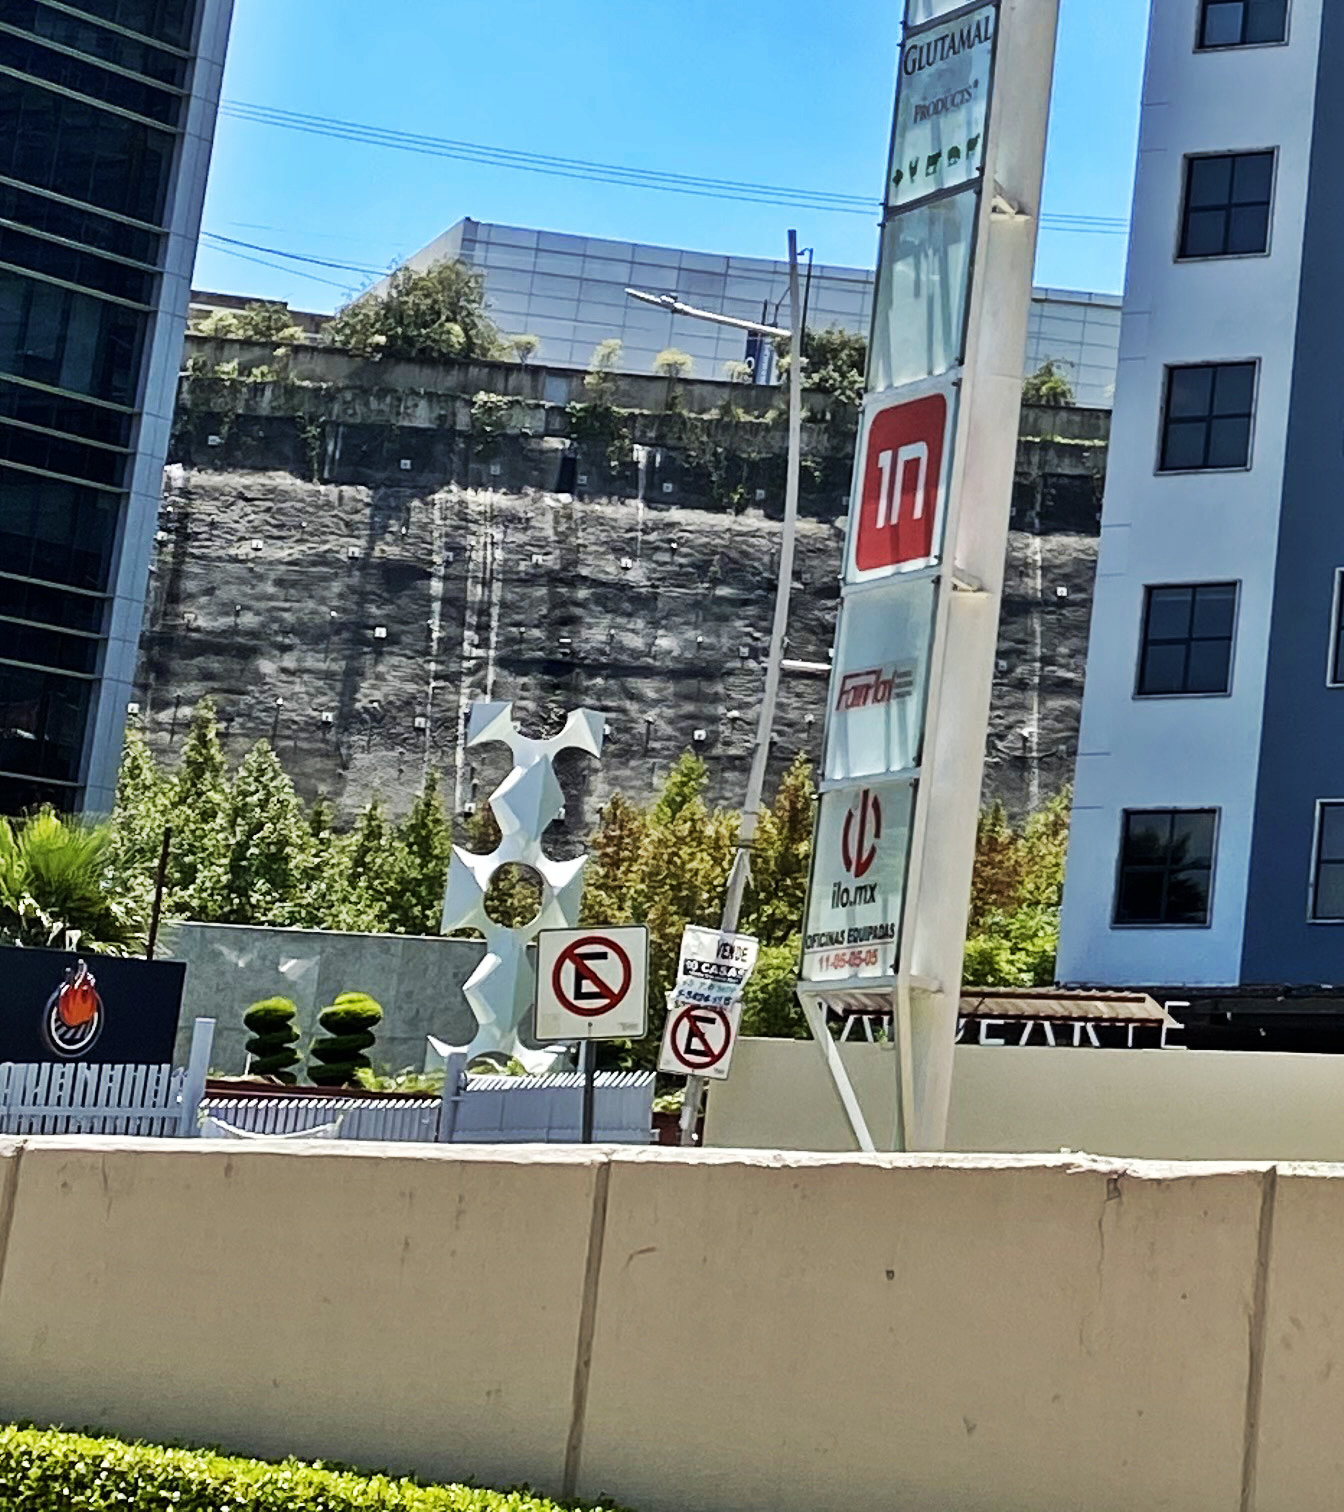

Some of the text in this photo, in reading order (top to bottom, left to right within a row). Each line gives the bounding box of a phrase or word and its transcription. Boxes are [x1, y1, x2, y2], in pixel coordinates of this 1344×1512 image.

[903, 15, 992, 76] GLUTAMAL
[913, 86, 973, 125] PRODUCTS
[831, 881, 878, 909] ilo.mx
